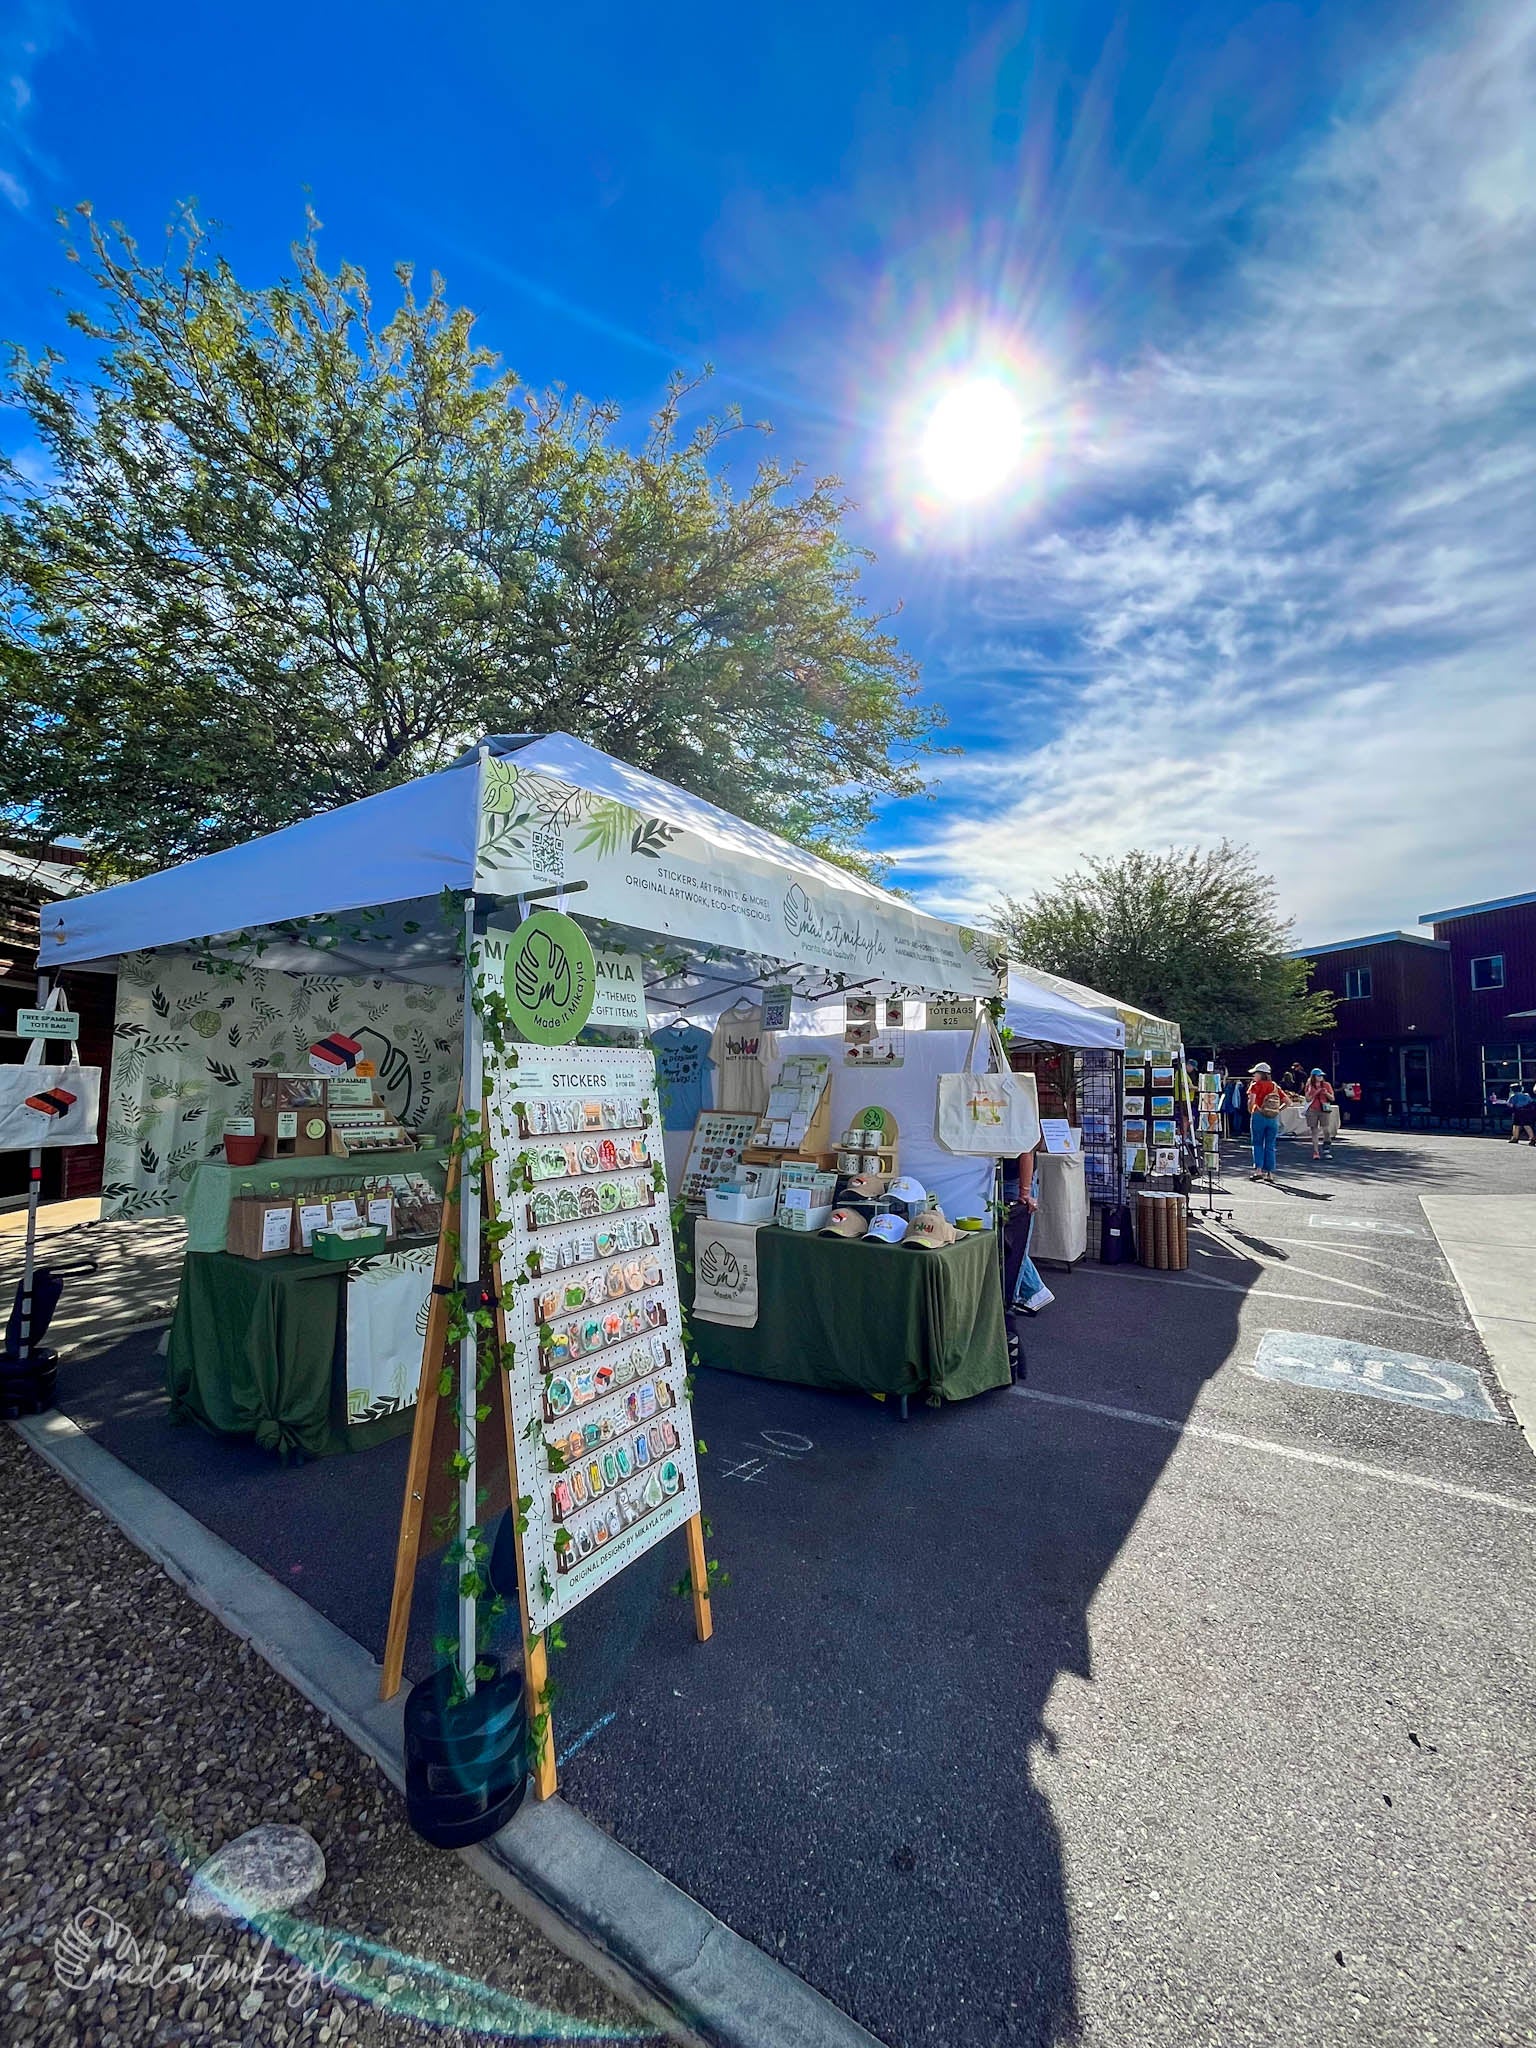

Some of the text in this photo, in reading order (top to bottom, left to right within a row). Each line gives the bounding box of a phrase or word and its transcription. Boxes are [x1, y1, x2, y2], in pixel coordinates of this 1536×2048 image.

[658, 868, 699, 889] STICKERS,
[700, 881, 712, 893] ART
[741, 893, 748, 902] &
[625, 875, 771, 922] ORIGINAL ARTWORK, ECO-CONSCIOUS
[596, 1006, 613, 1016] GIFT
[615, 1007, 638, 1018] ITEMS
[929, 1006, 974, 1015] TOTE BAGS
[533, 1014, 561, 1028] Made
[943, 1018, 959, 1026] $25
[552, 1074, 607, 1088] STICKERS
[569, 1507, 673, 1587] ORIGINAL DESIGNS BY MIKAYLA CHIN
